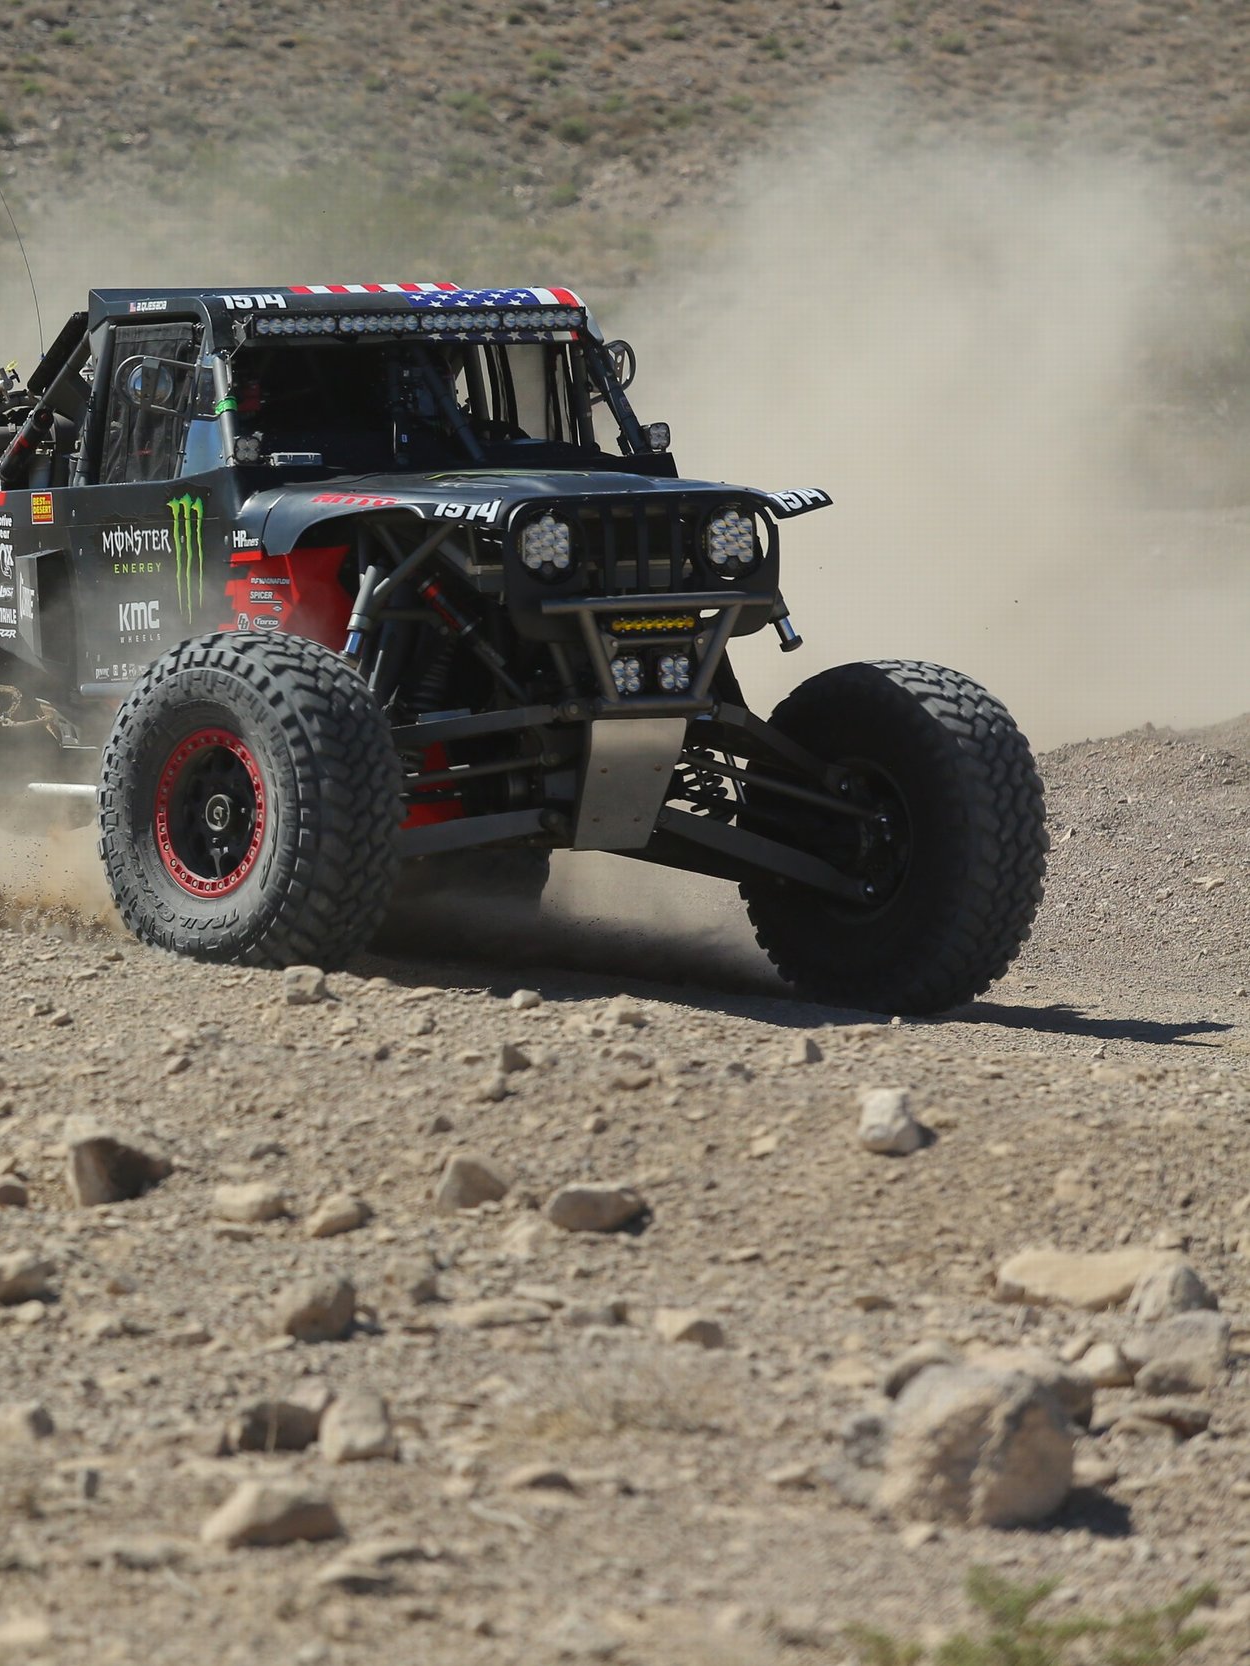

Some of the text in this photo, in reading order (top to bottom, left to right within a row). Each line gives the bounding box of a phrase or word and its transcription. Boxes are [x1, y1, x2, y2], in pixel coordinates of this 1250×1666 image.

[219, 294, 287, 310] 1514
[766, 488, 827, 512] 1514
[434, 500, 502, 523] 1514
[102, 525, 172, 558] MONSTER
[114, 562, 162, 574] ENERGY
[250, 591, 273, 600] SPICER
[119, 600, 160, 632] KMC
[256, 618, 279, 626] Torco
[120, 633, 161, 643] WHEELS
